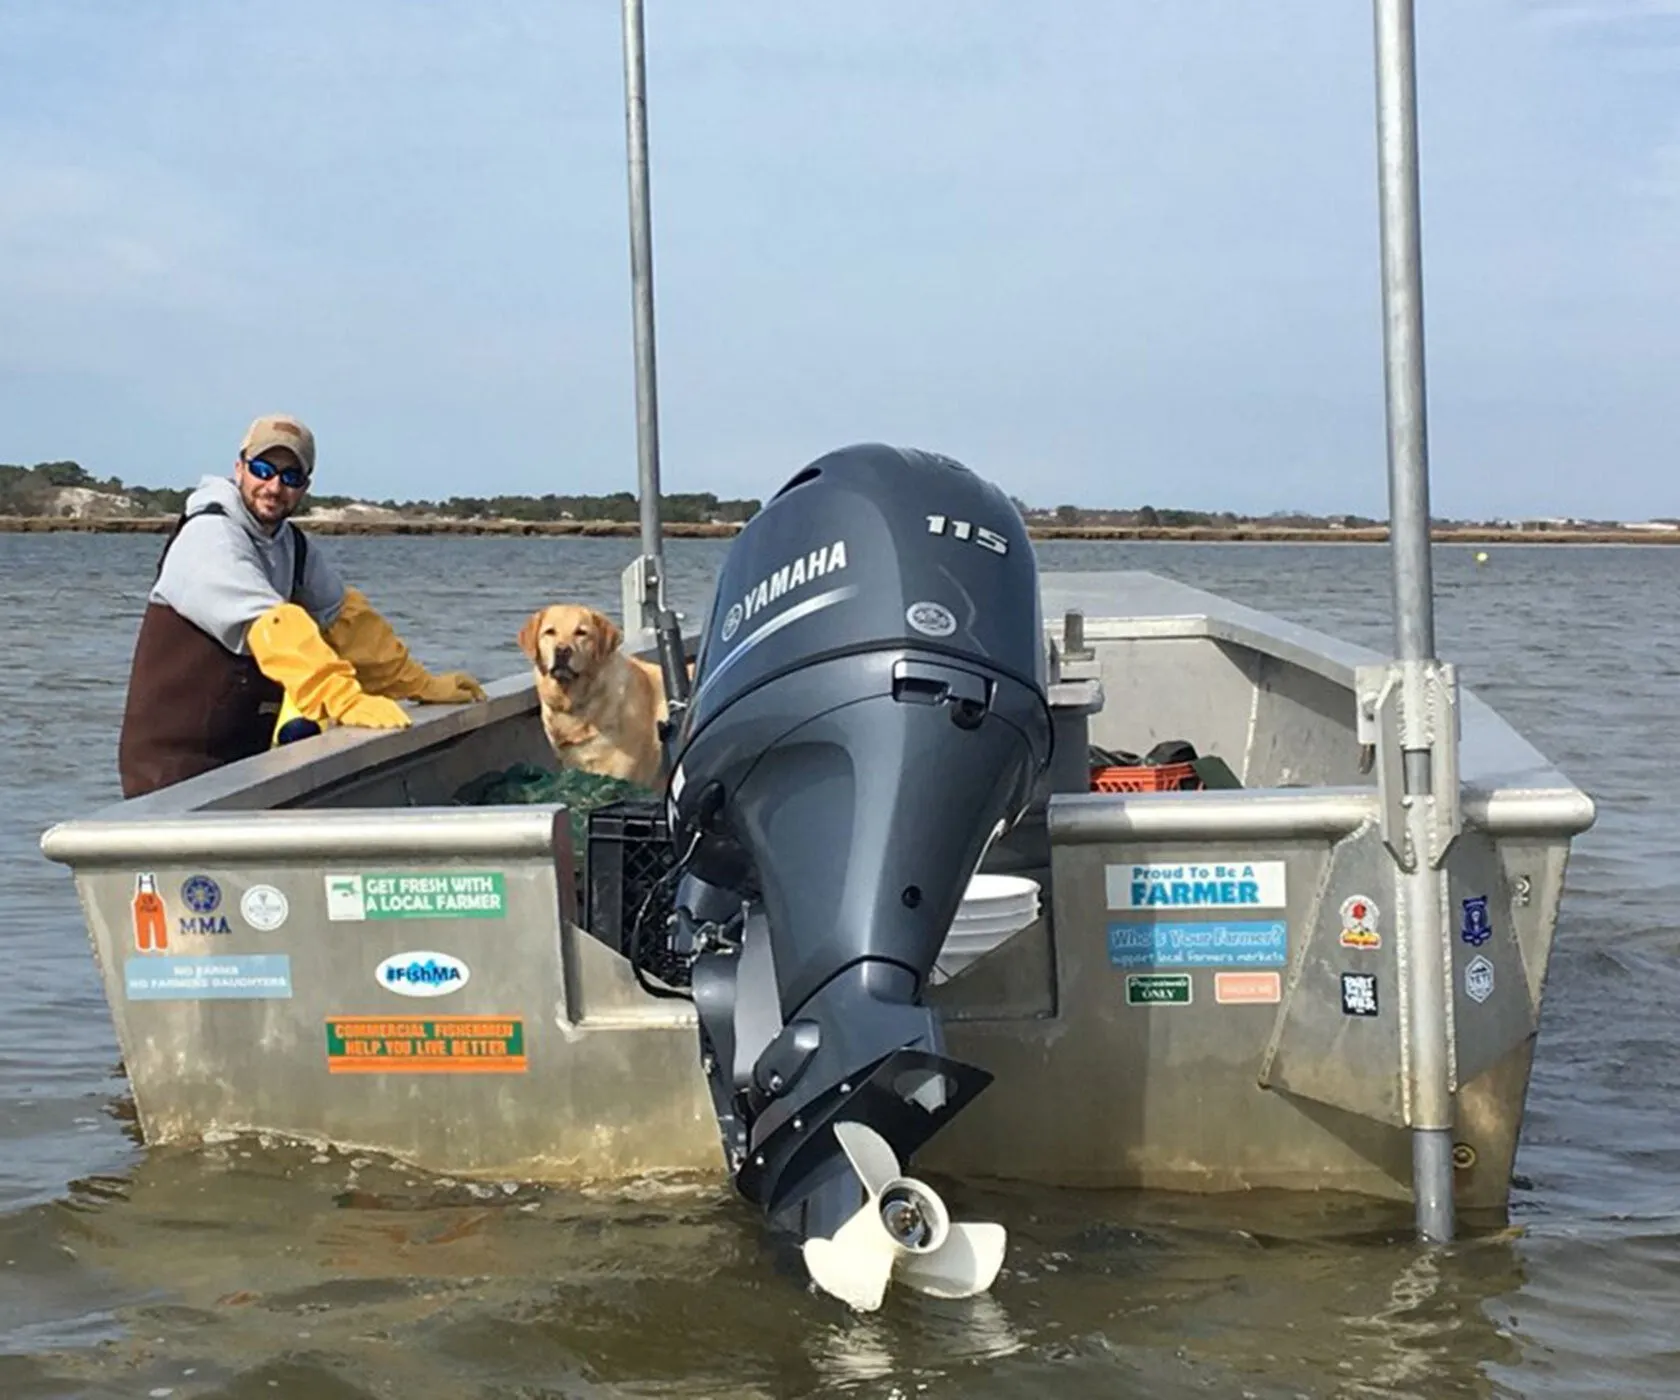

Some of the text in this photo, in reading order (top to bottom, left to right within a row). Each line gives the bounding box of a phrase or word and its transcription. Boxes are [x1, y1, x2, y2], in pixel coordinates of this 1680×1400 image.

[925, 514, 1009, 555] 115
[743, 540, 848, 621] YAMAHA
[1133, 865, 1255, 880] Proud To Be A
[366, 876, 493, 894] GET FRESH WITH
[1131, 881, 1260, 905] FARMER
[366, 894, 501, 912] A LOCAL FARMER
[179, 916, 232, 934] MMA
[1169, 928, 1212, 948] Your
[385, 966, 462, 983] #FishMA
[1141, 989, 1176, 999] ONLY
[334, 1023, 427, 1038] COMMERCIAL
[345, 1040, 507, 1056] HELP YOU LIVE BETTER
